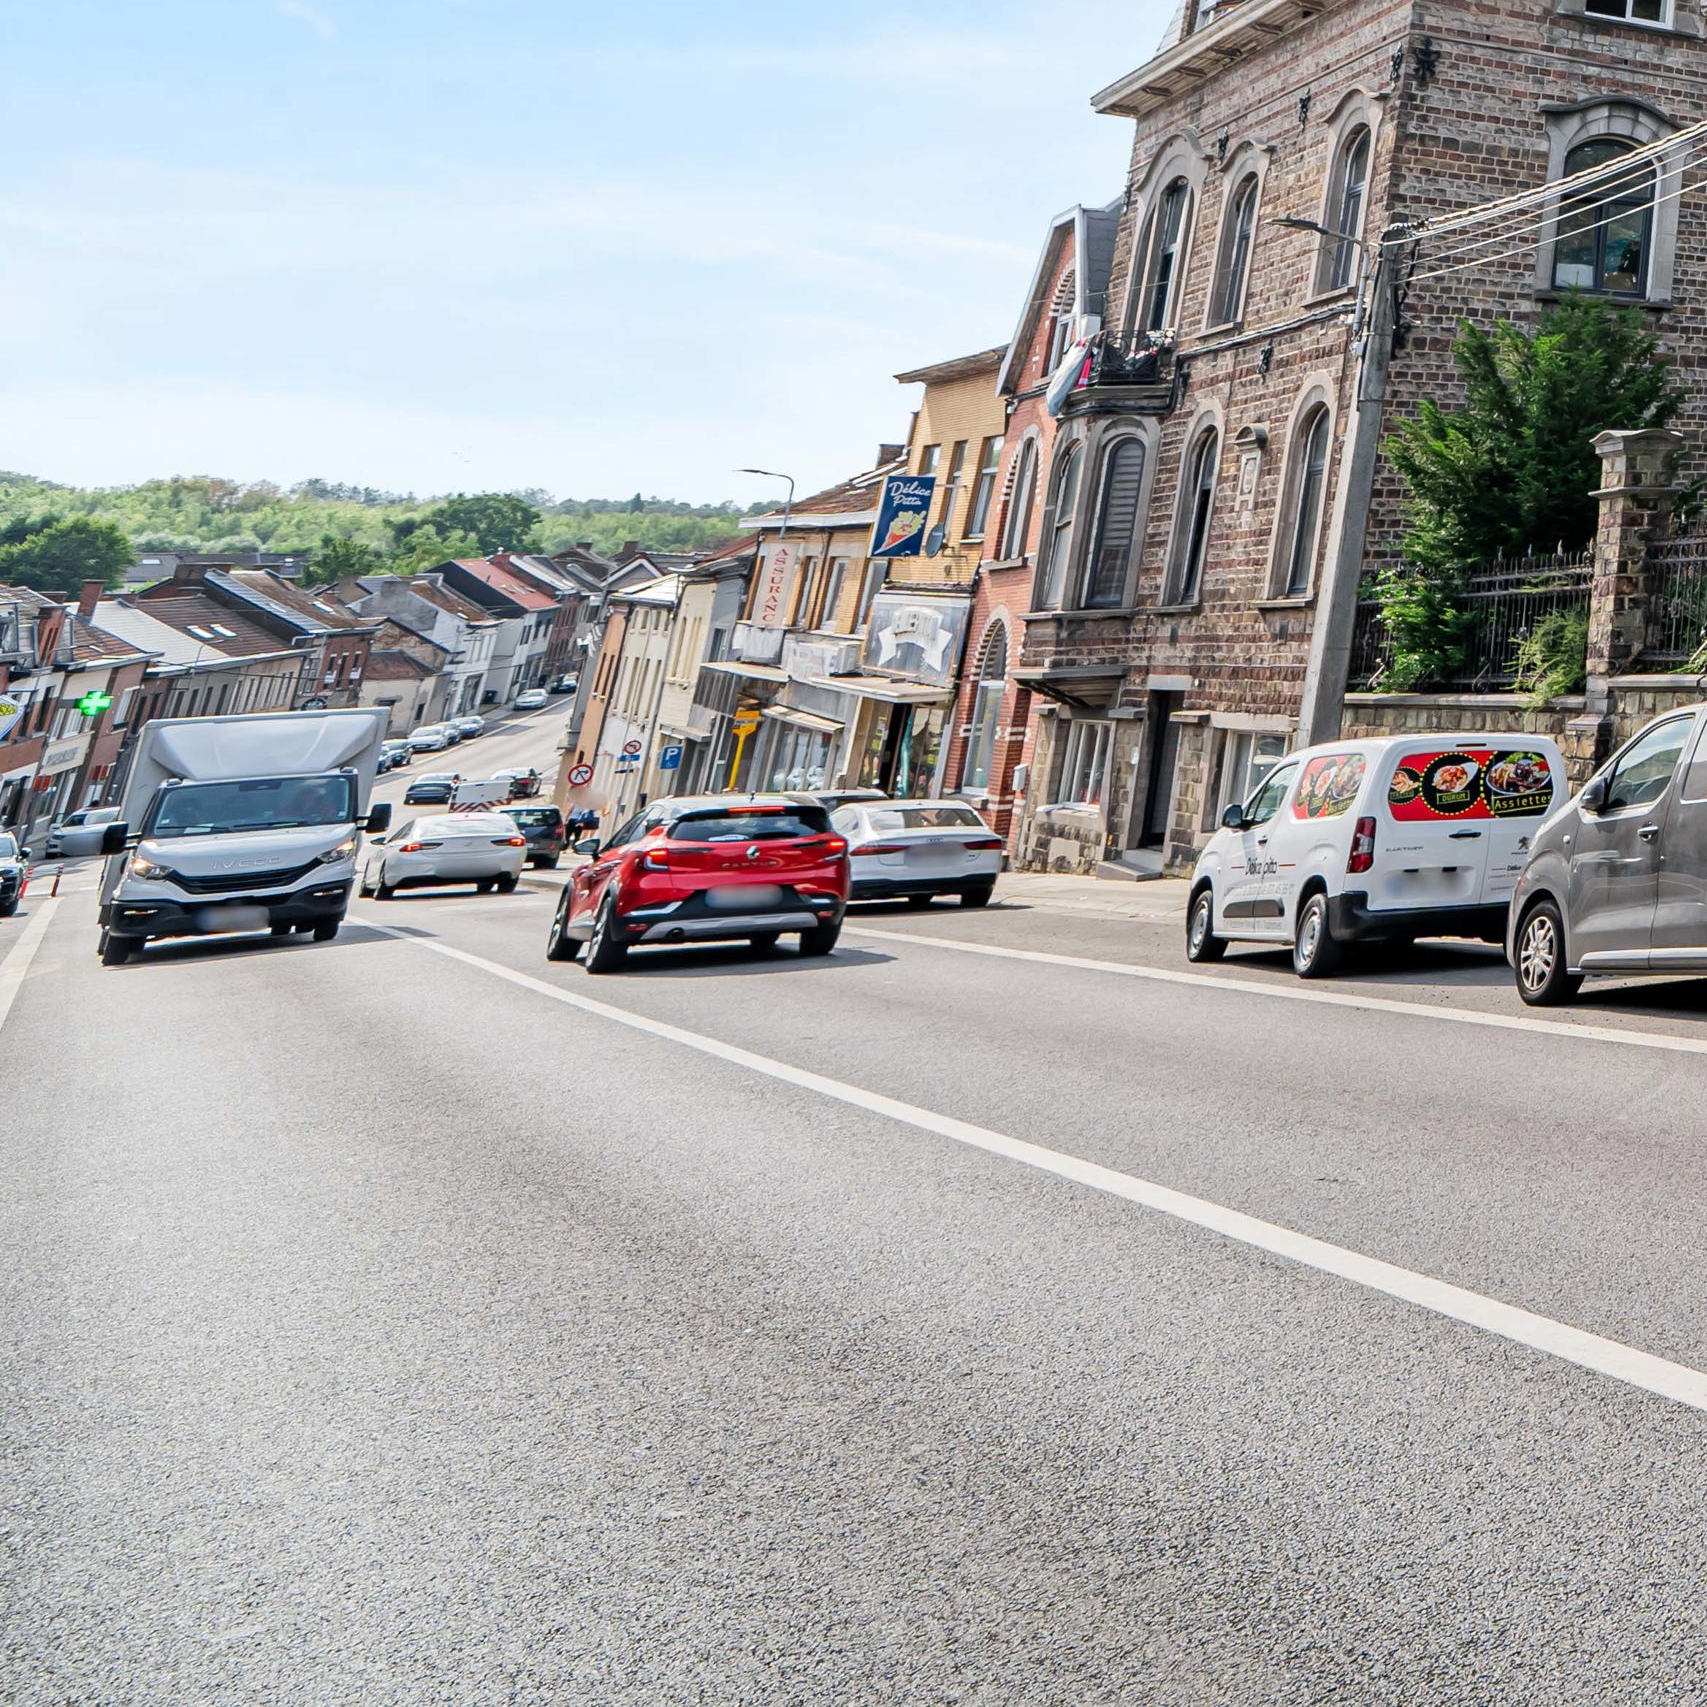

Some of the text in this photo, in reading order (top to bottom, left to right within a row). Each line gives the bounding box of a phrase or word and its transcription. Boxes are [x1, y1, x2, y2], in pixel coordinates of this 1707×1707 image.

[888, 481, 932, 497] Délice
[666, 747, 678, 761] P
[1494, 794, 1552, 810] Assiettes
